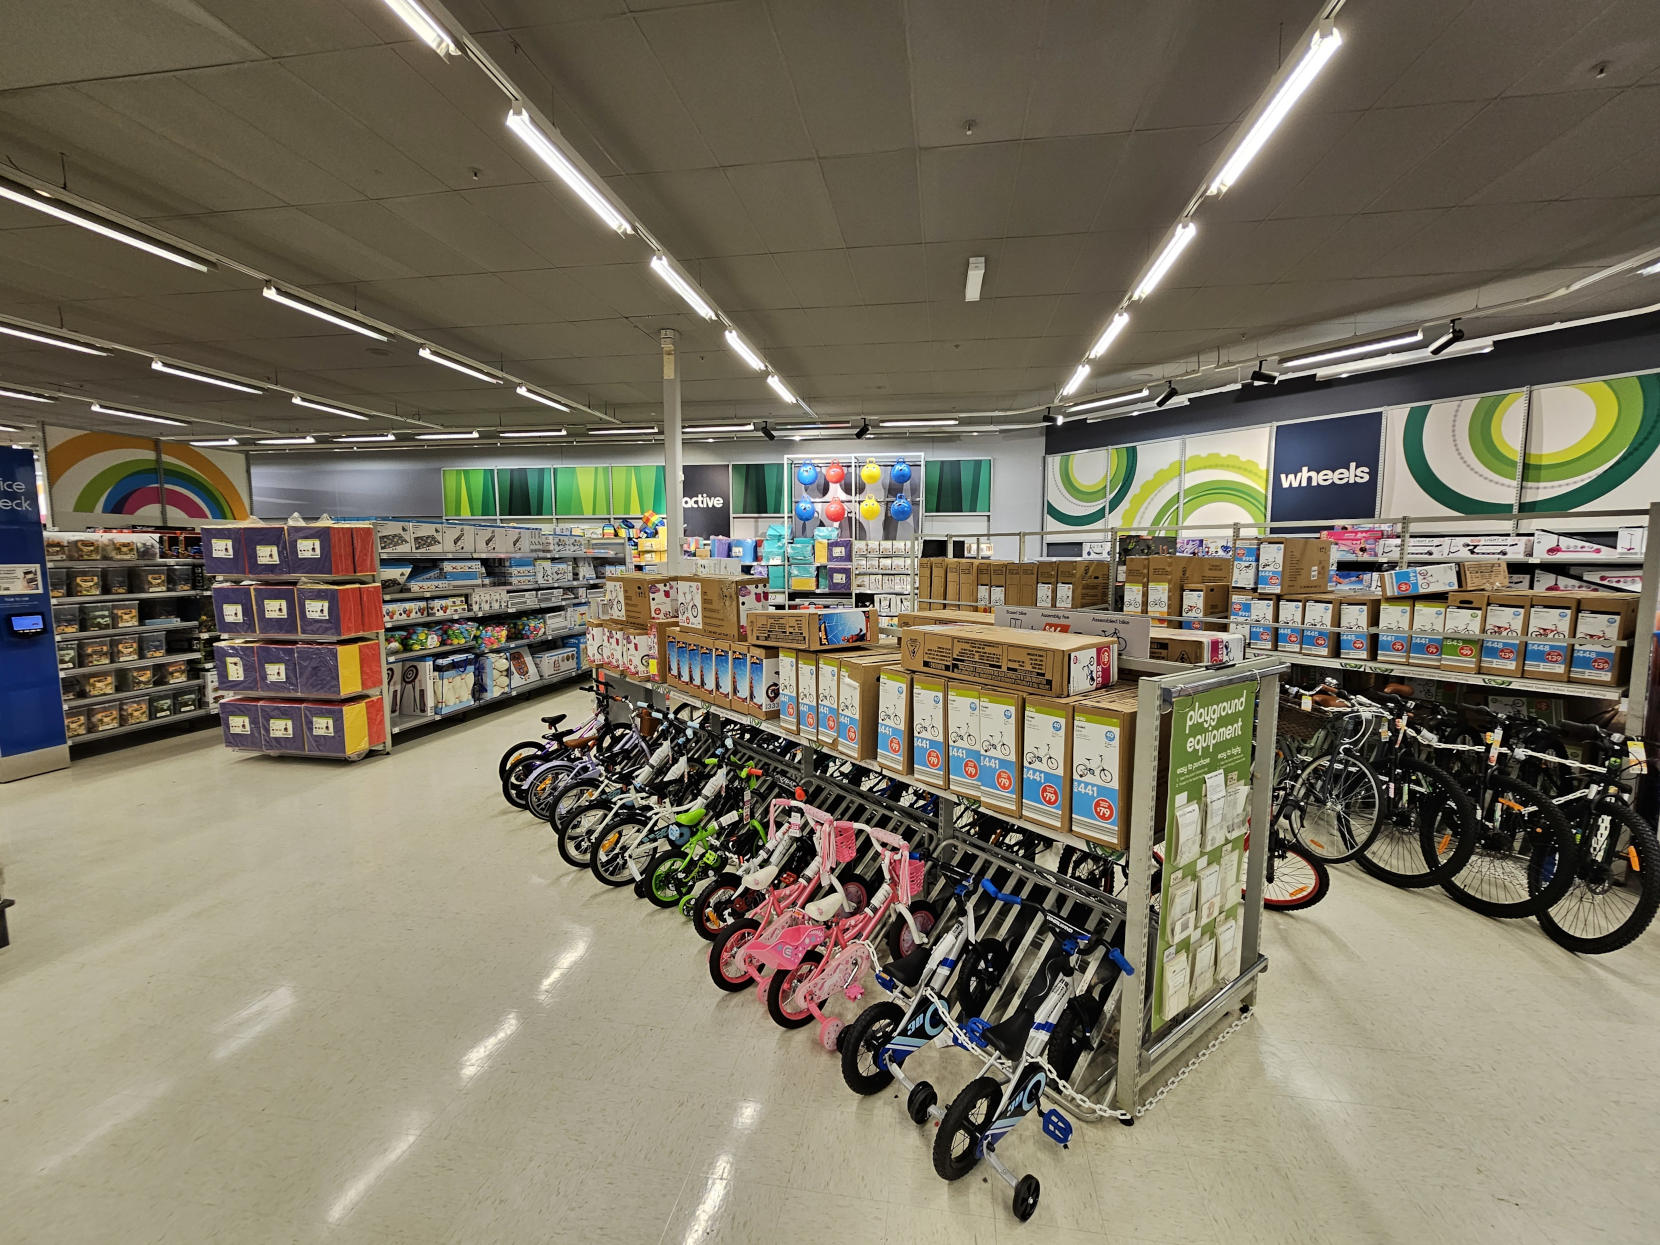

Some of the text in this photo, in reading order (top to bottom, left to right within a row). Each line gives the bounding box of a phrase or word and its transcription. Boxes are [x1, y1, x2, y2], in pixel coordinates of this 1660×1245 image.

[1280, 462, 1370, 488] wheels
[682, 494, 724, 508] active
[1186, 690, 1246, 734] playground
[1186, 718, 1242, 756] equipment
[1044, 791, 1055, 802] $79
[1097, 806, 1110, 816] $79
